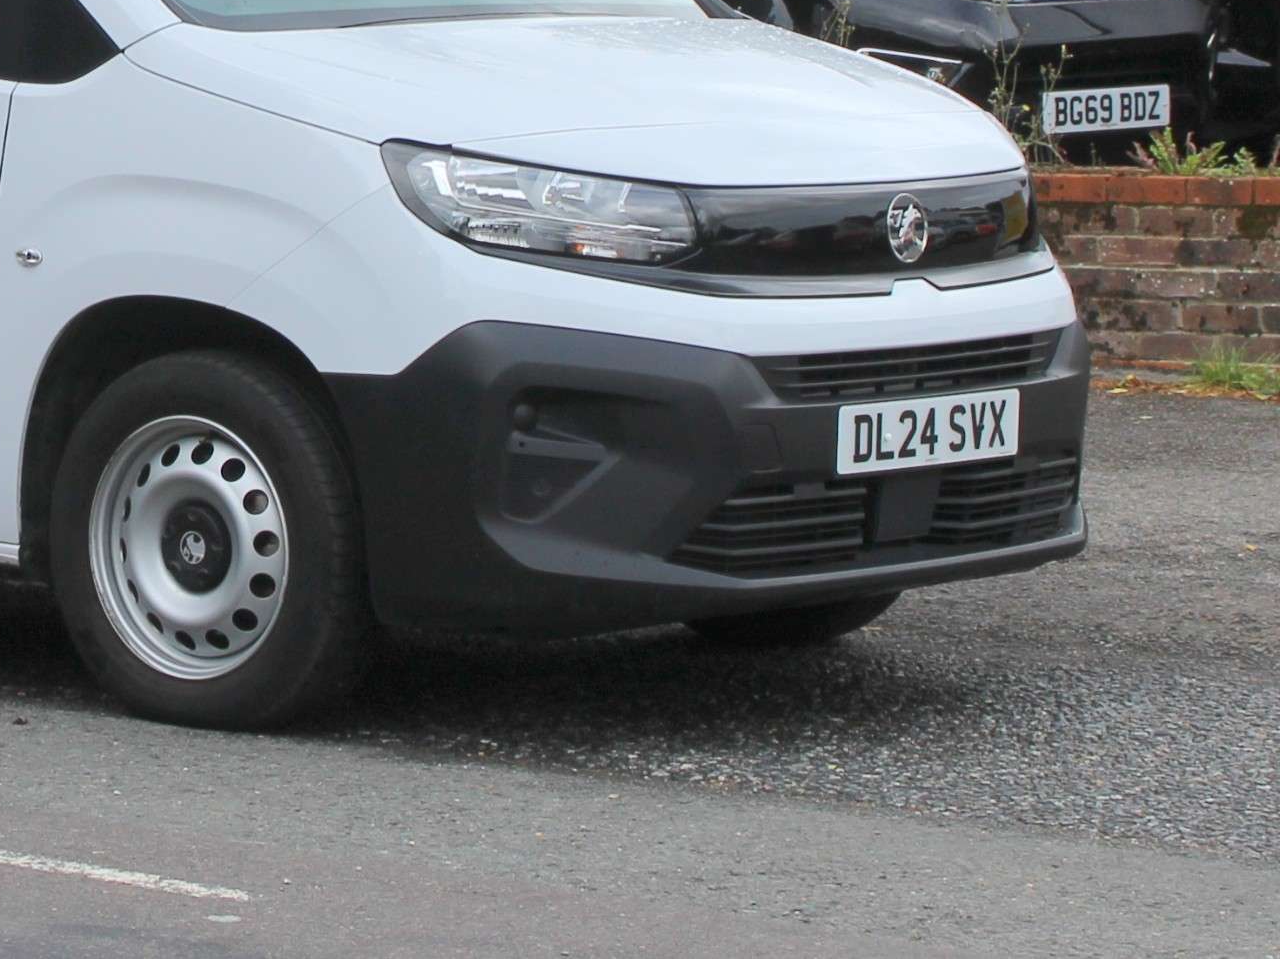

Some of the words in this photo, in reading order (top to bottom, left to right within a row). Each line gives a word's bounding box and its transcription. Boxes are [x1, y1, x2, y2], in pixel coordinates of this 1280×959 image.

[1054, 94, 1113, 127] BG69
[1120, 91, 1160, 123] BDZ
[852, 407, 938, 463] DL24
[948, 399, 1007, 453] SVX
